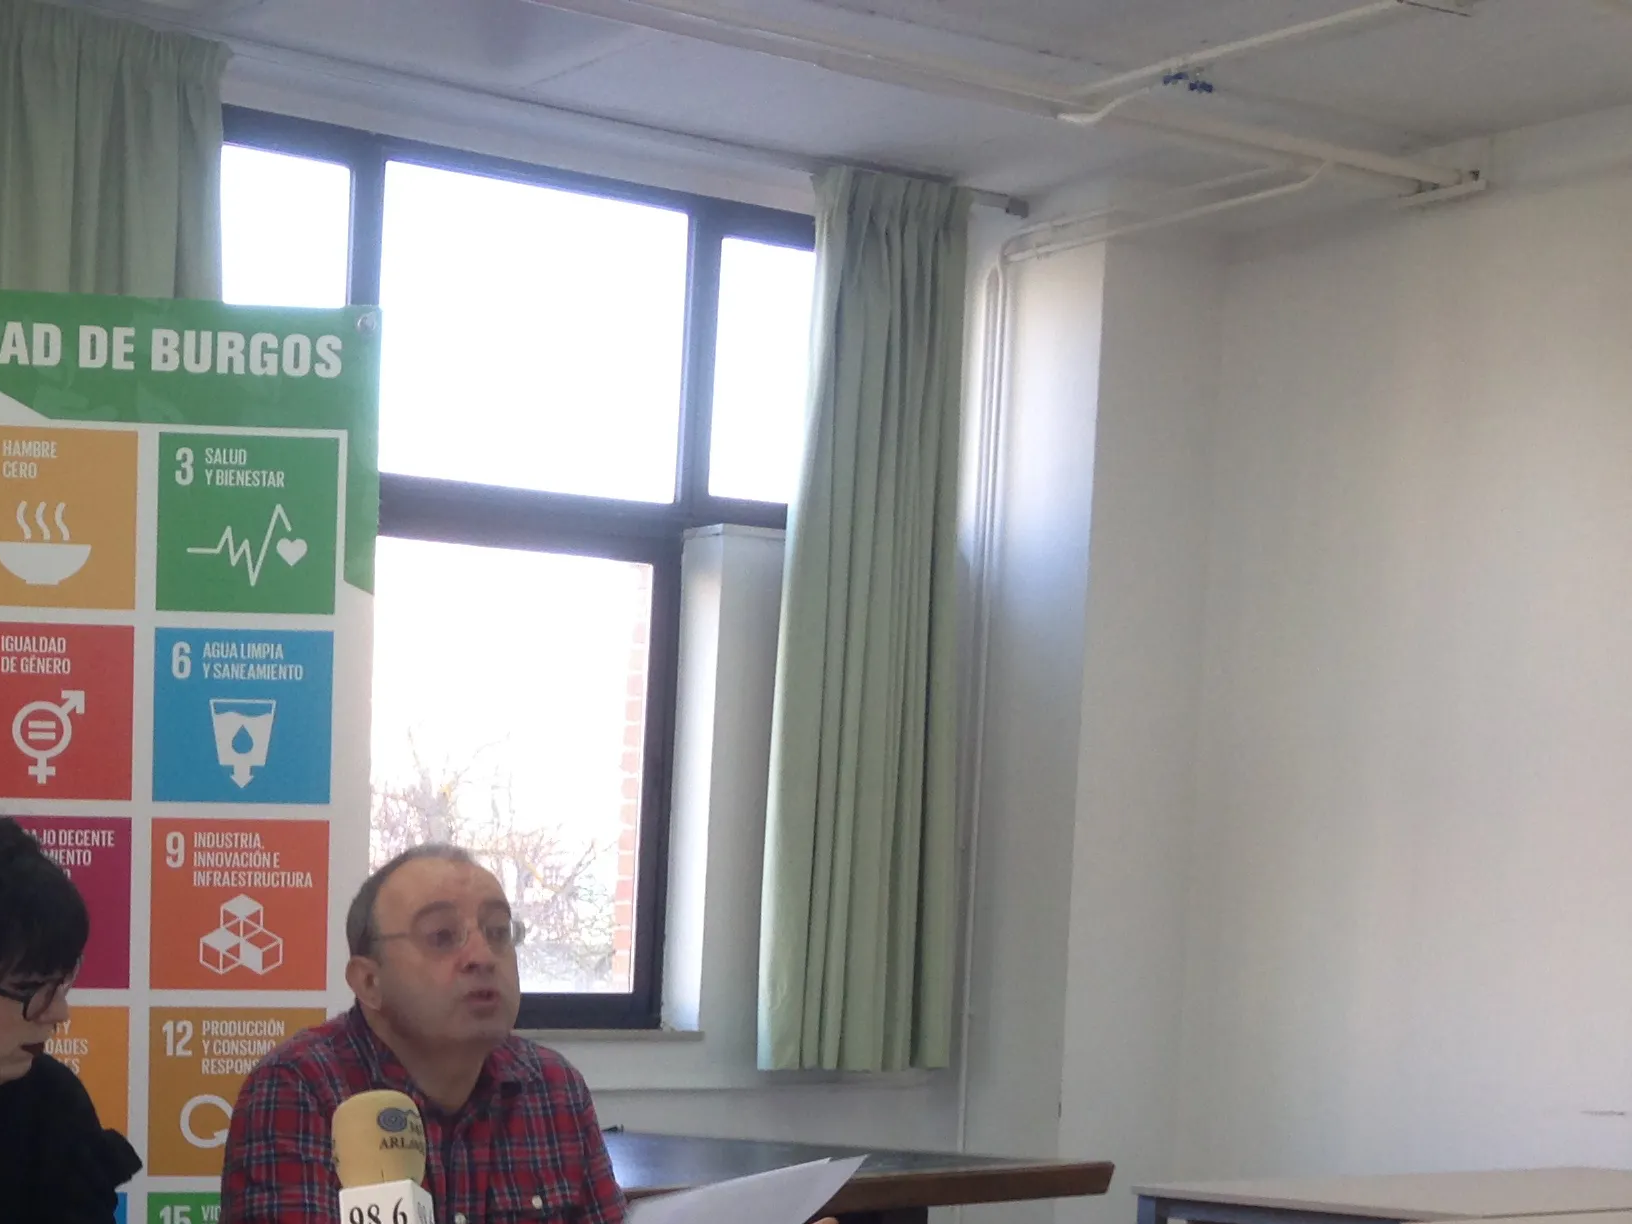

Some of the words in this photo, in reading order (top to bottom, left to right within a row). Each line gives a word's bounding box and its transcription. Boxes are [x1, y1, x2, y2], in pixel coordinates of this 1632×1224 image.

[79, 326, 134, 370] DE
[151, 329, 342, 378] BURGOS
[2, 440, 57, 459] HAMBRE
[2, 461, 37, 478] CERO
[175, 447, 194, 485] 3
[205, 448, 247, 465] SALUD
[205, 469, 213, 485] Y
[216, 469, 285, 487] BIENESTAR
[1, 636, 66, 653] IGUALDAD
[1, 656, 17, 672] DE
[20, 654, 70, 674] GÉNERO
[172, 641, 191, 679] 6
[203, 642, 238, 659] AGUA
[241, 643, 284, 660] LIMPIA
[203, 664, 209, 678] Y
[213, 664, 303, 680] SANEAMIENTO
[59, 829, 115, 847] DECENTE
[166, 831, 185, 868] 9
[194, 851, 270, 868] INNOVACIÓN
[273, 853, 280, 868] E
[194, 871, 312, 888] INFRAESTRUCTURA
[163, 1020, 192, 1056] 12
[202, 1019, 284, 1036] PRODUCCIÓN
[202, 1040, 209, 1055] Y
